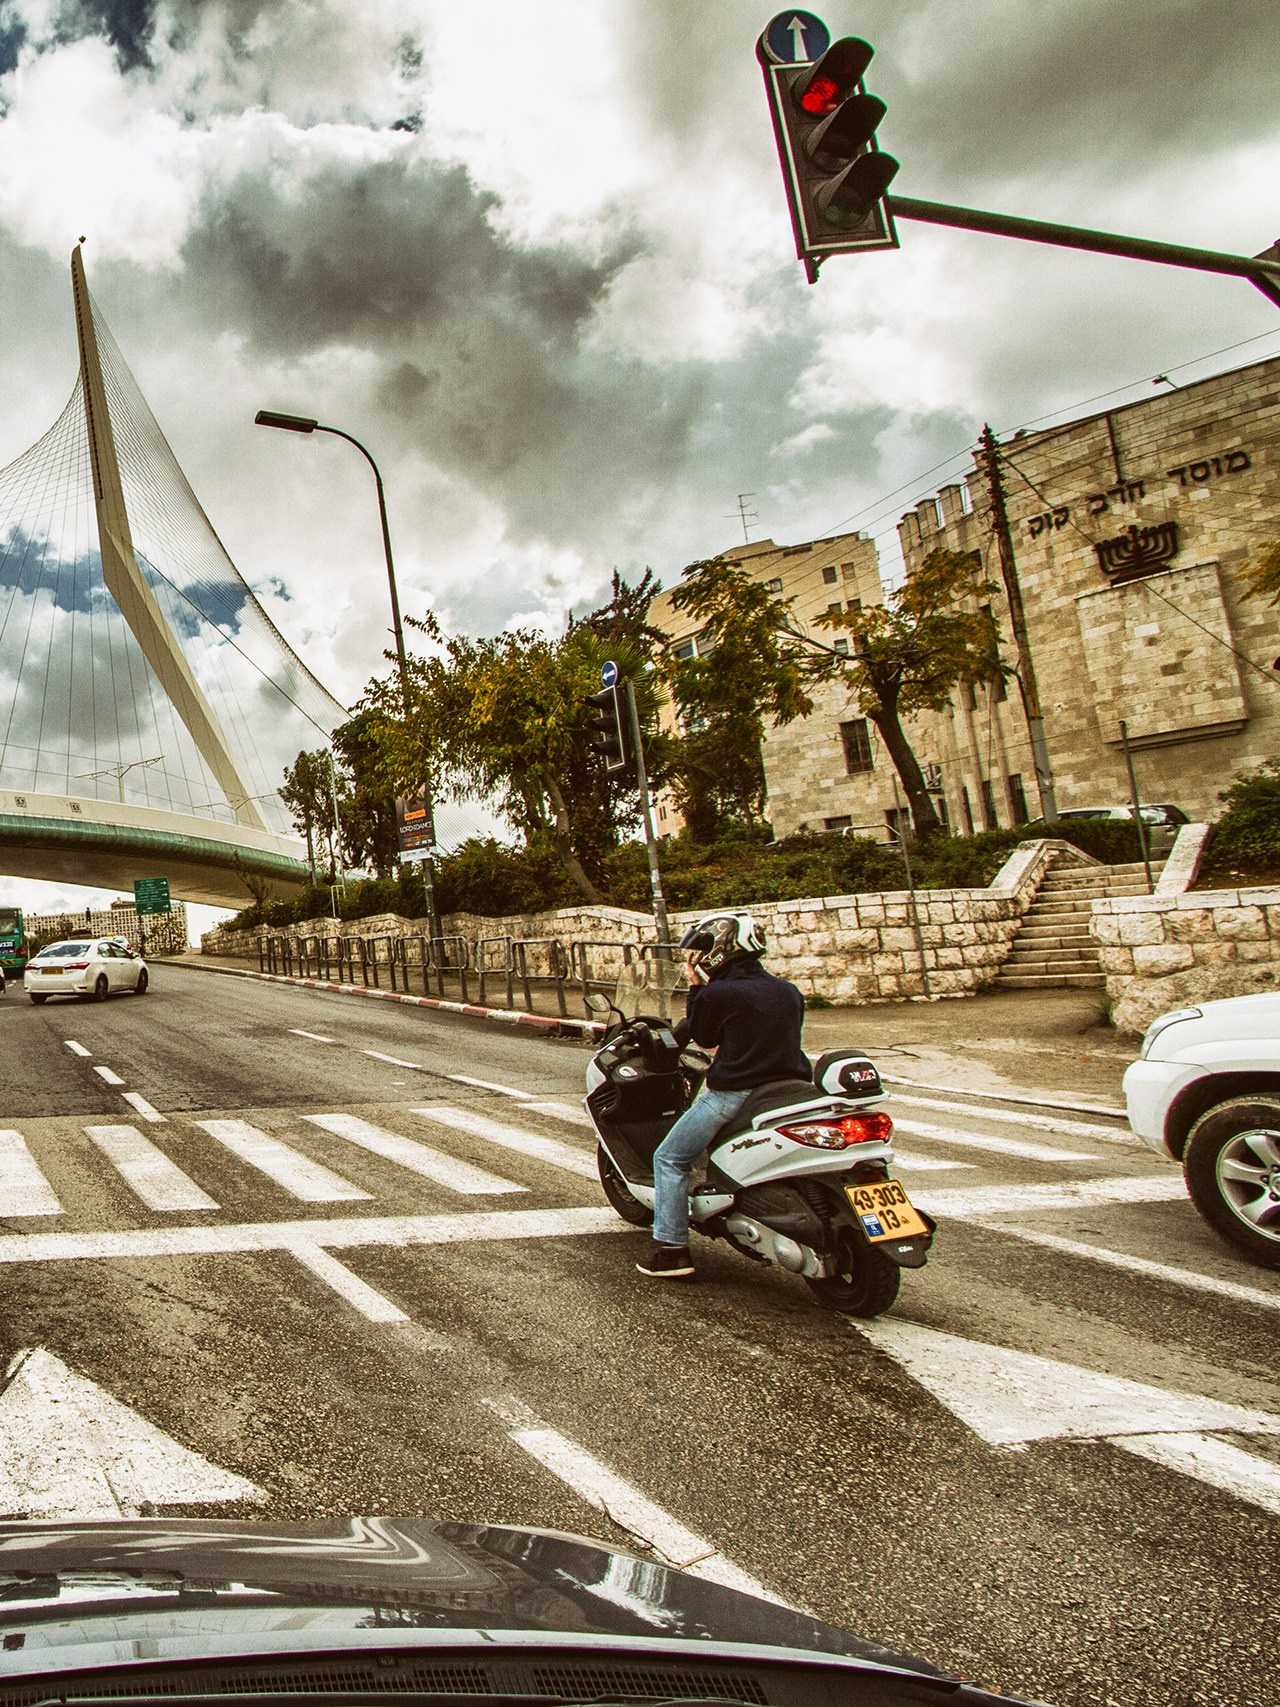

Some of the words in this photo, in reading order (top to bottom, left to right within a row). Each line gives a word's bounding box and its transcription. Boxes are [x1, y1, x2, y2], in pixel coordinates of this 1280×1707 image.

[1167, 450, 1251, 486] מוסד
[1087, 480, 1144, 515] הרב
[1027, 506, 1069, 539] קוק
[878, 1209, 901, 1230] 13
